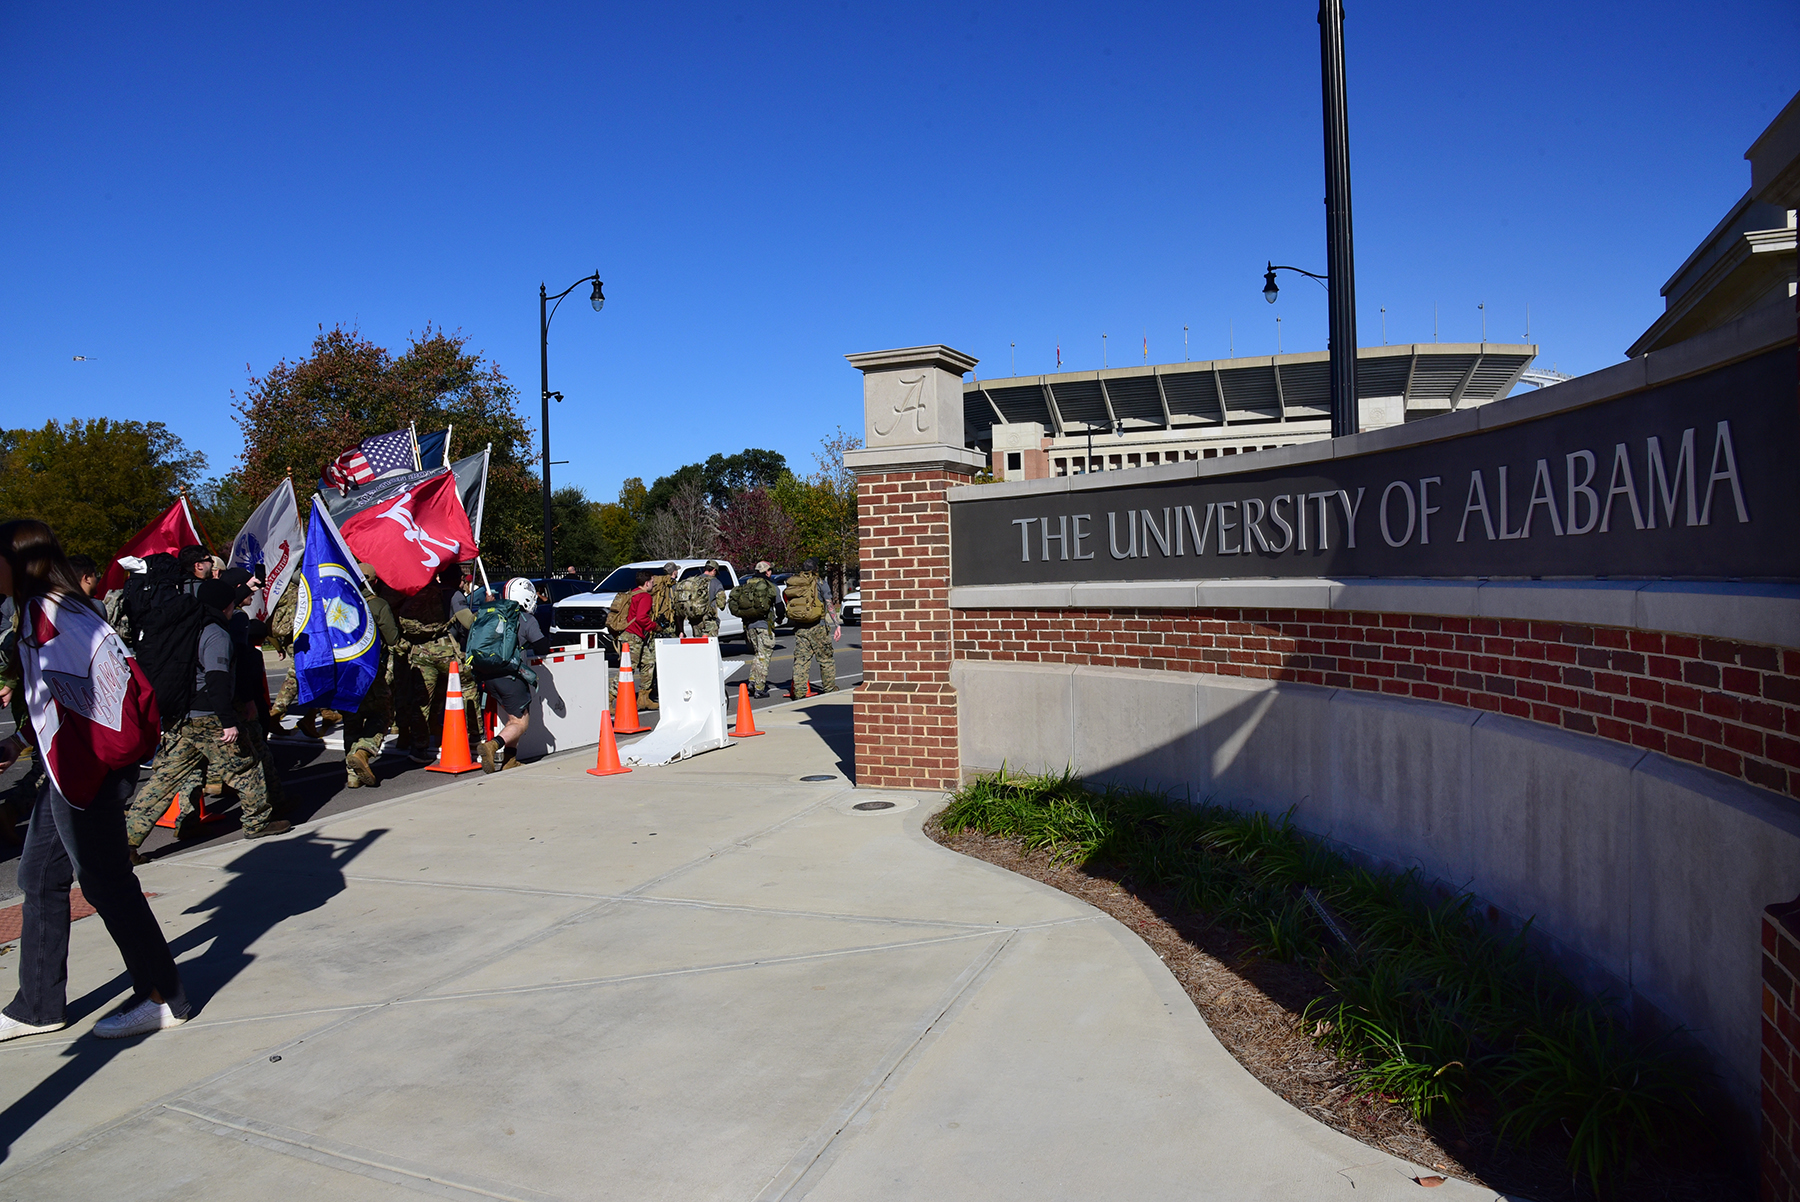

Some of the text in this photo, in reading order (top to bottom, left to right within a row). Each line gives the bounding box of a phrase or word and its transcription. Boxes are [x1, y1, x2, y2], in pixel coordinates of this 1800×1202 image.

[873, 374, 930, 437] A
[1012, 420, 1749, 562] THE UNIVERSITY OF ALABAMA
[359, 635, 370, 649] AIR
[51, 650, 126, 724] ALABAMA
